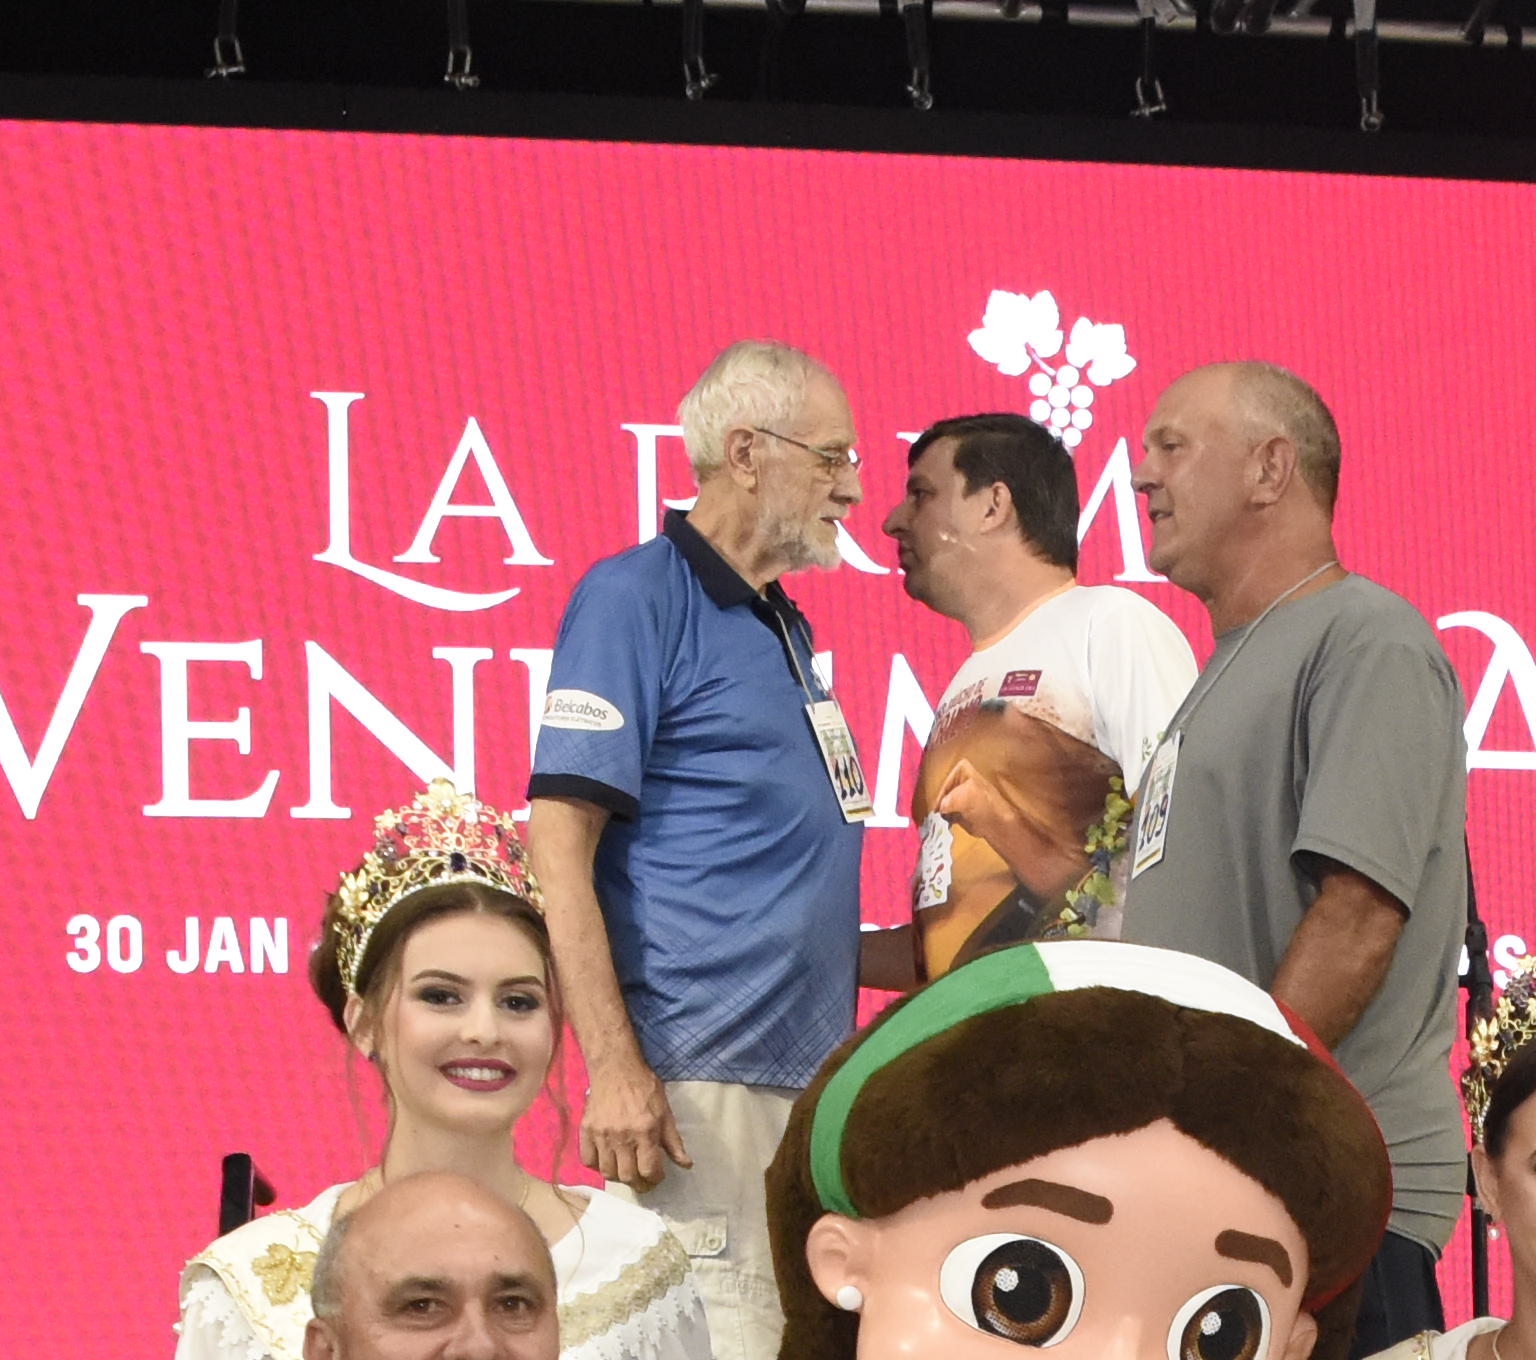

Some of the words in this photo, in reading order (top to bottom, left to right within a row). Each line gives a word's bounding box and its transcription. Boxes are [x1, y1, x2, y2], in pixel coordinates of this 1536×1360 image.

[311, 392, 554, 612] LA
[554, 698, 609, 721] Belcabos
[834, 755, 864, 800] 110
[1139, 794, 1169, 851] 109
[67, 914, 143, 974] 30
[167, 916, 289, 974] JAN
